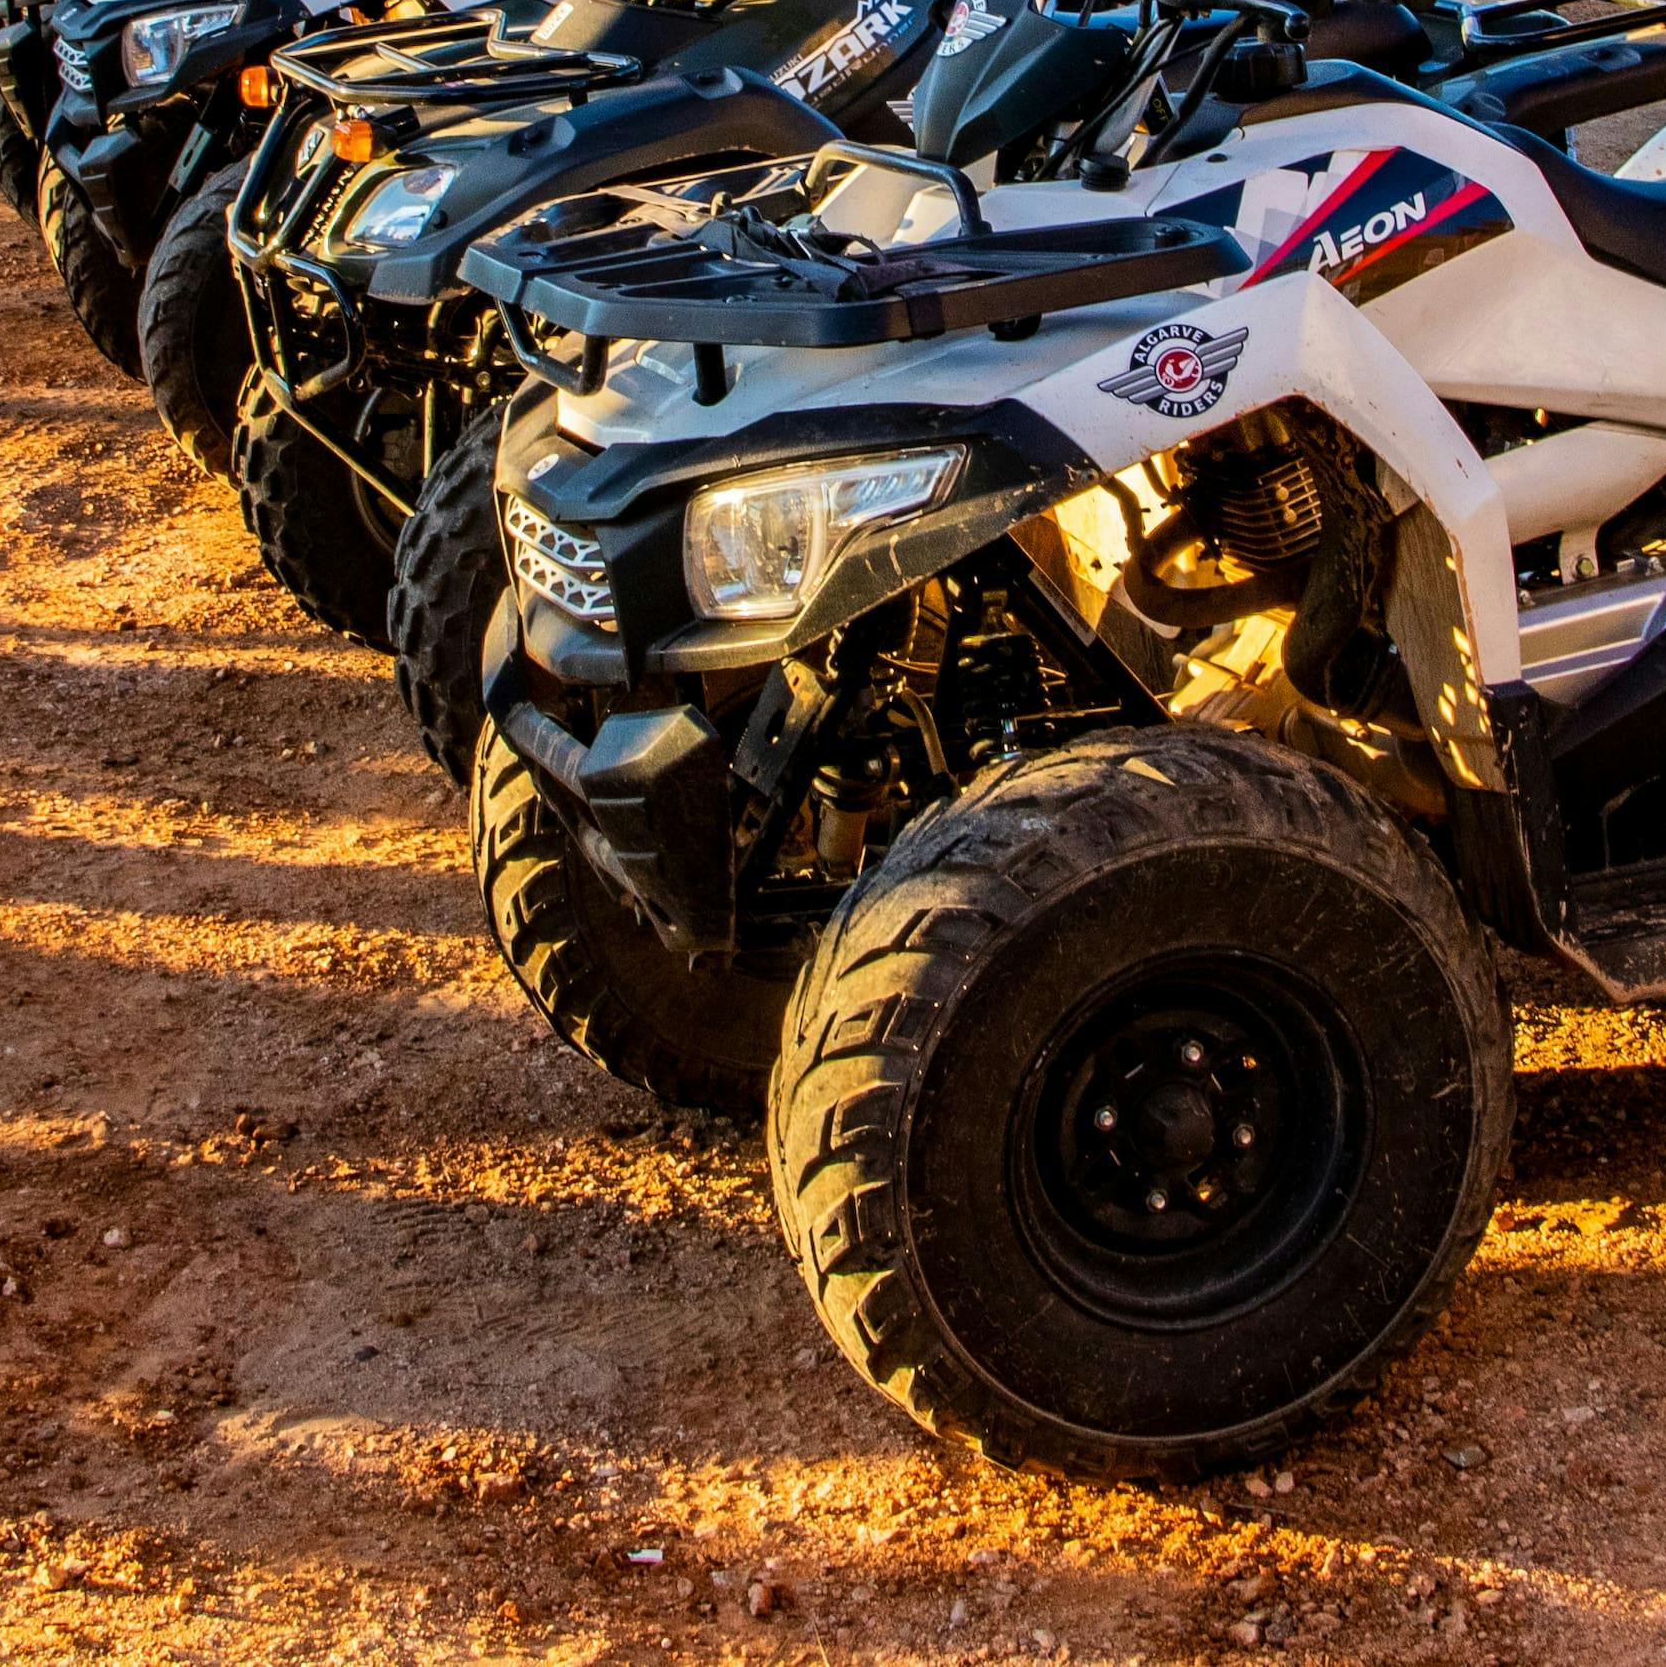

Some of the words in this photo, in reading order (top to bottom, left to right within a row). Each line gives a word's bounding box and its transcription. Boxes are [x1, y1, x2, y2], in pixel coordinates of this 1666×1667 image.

[769, 53, 804, 82] UZUKI
[1307, 191, 1427, 274] AEON
[1134, 325, 1204, 363] ALGARVE
[1158, 380, 1223, 416] RIDERS
